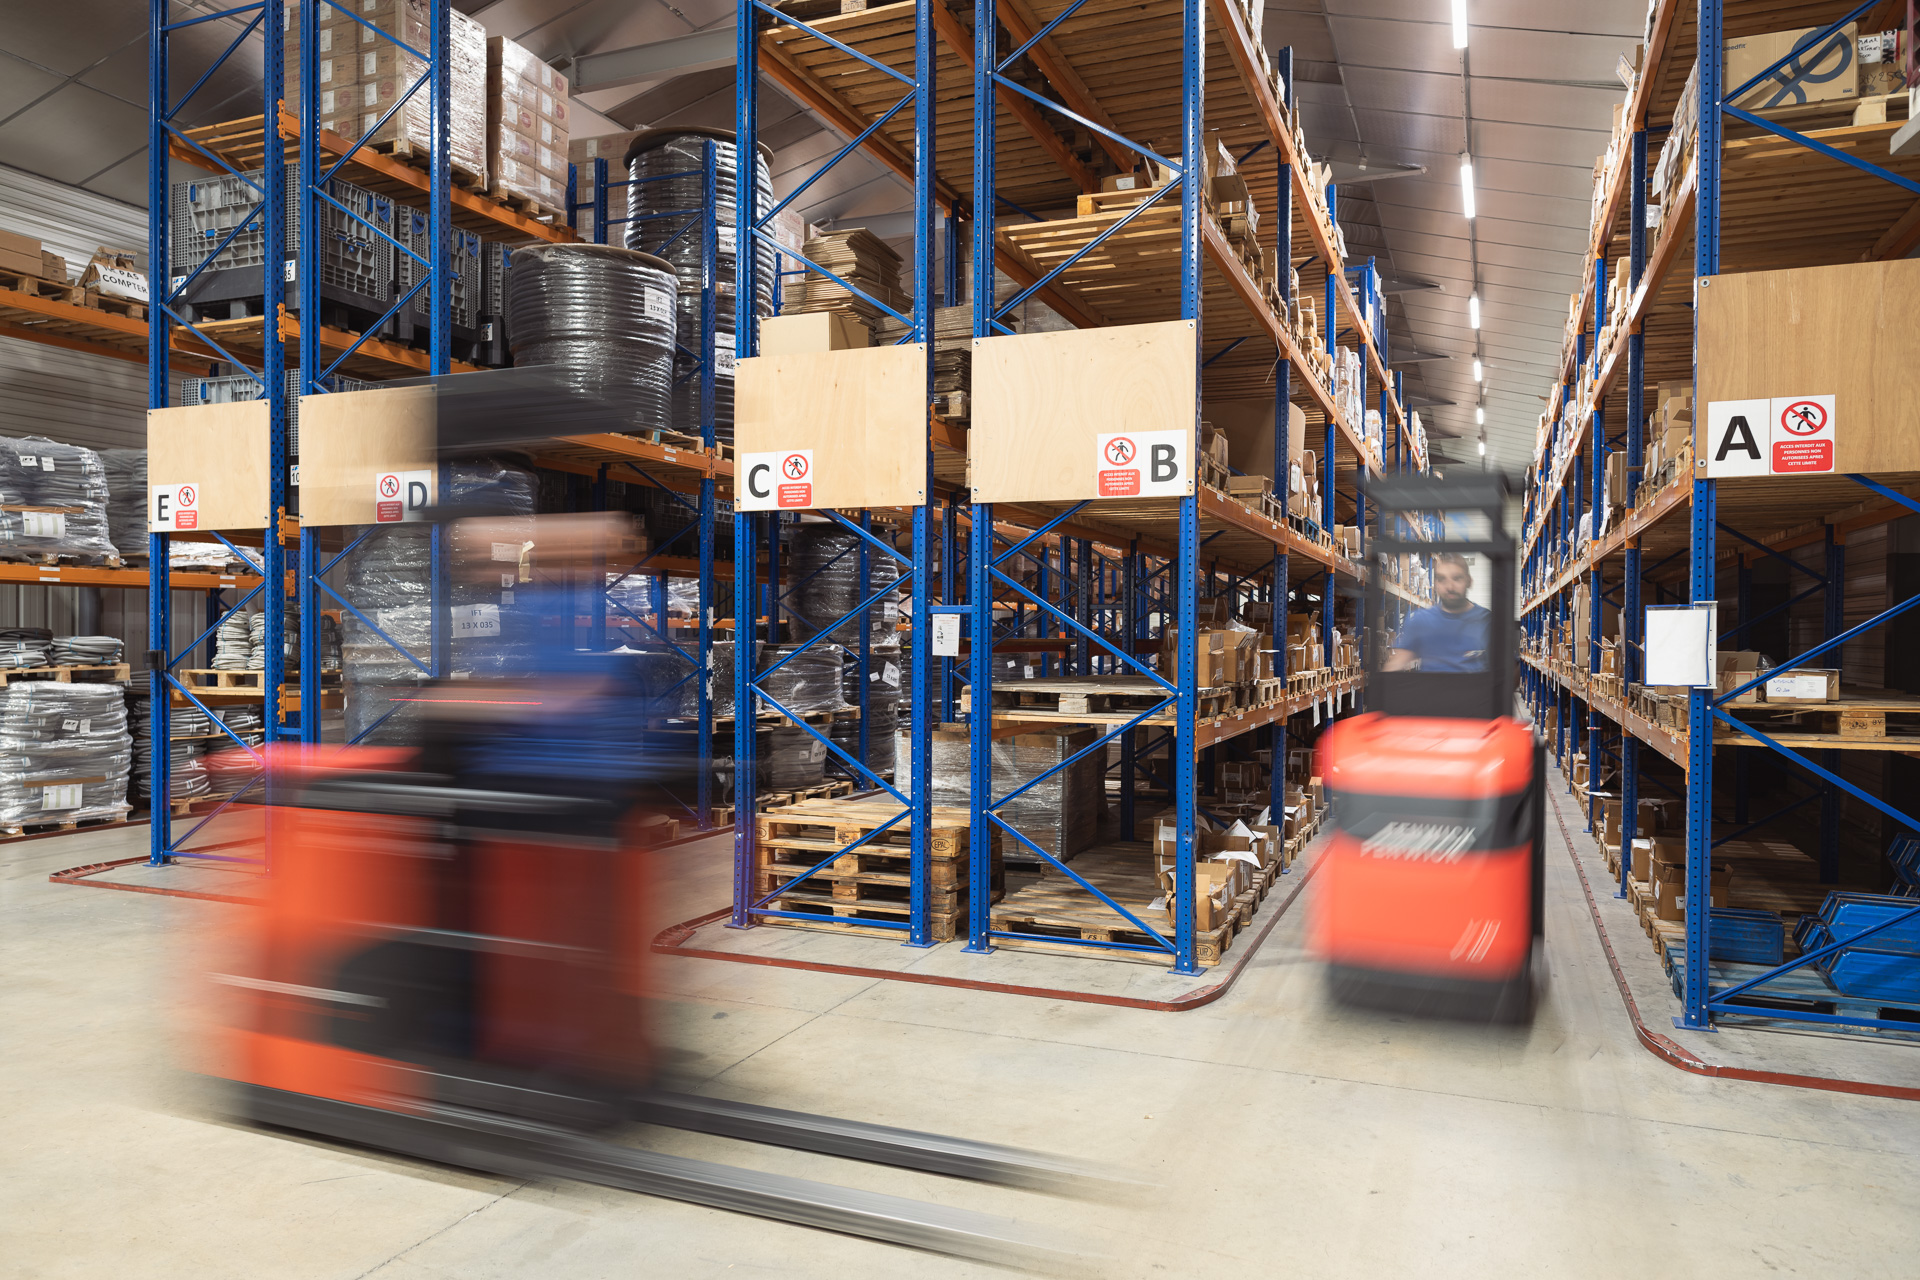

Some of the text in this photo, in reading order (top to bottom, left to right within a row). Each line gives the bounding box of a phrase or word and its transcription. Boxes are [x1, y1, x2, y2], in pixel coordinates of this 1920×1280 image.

[102, 274, 148, 294] COMPTER
[1715, 416, 1761, 461] A
[1151, 444, 1178, 482] B
[409, 481, 428, 511] D
[748, 463, 770, 499] C
[158, 494, 170, 521] E
[473, 621, 478, 629] X
[480, 621, 493, 629] 035
